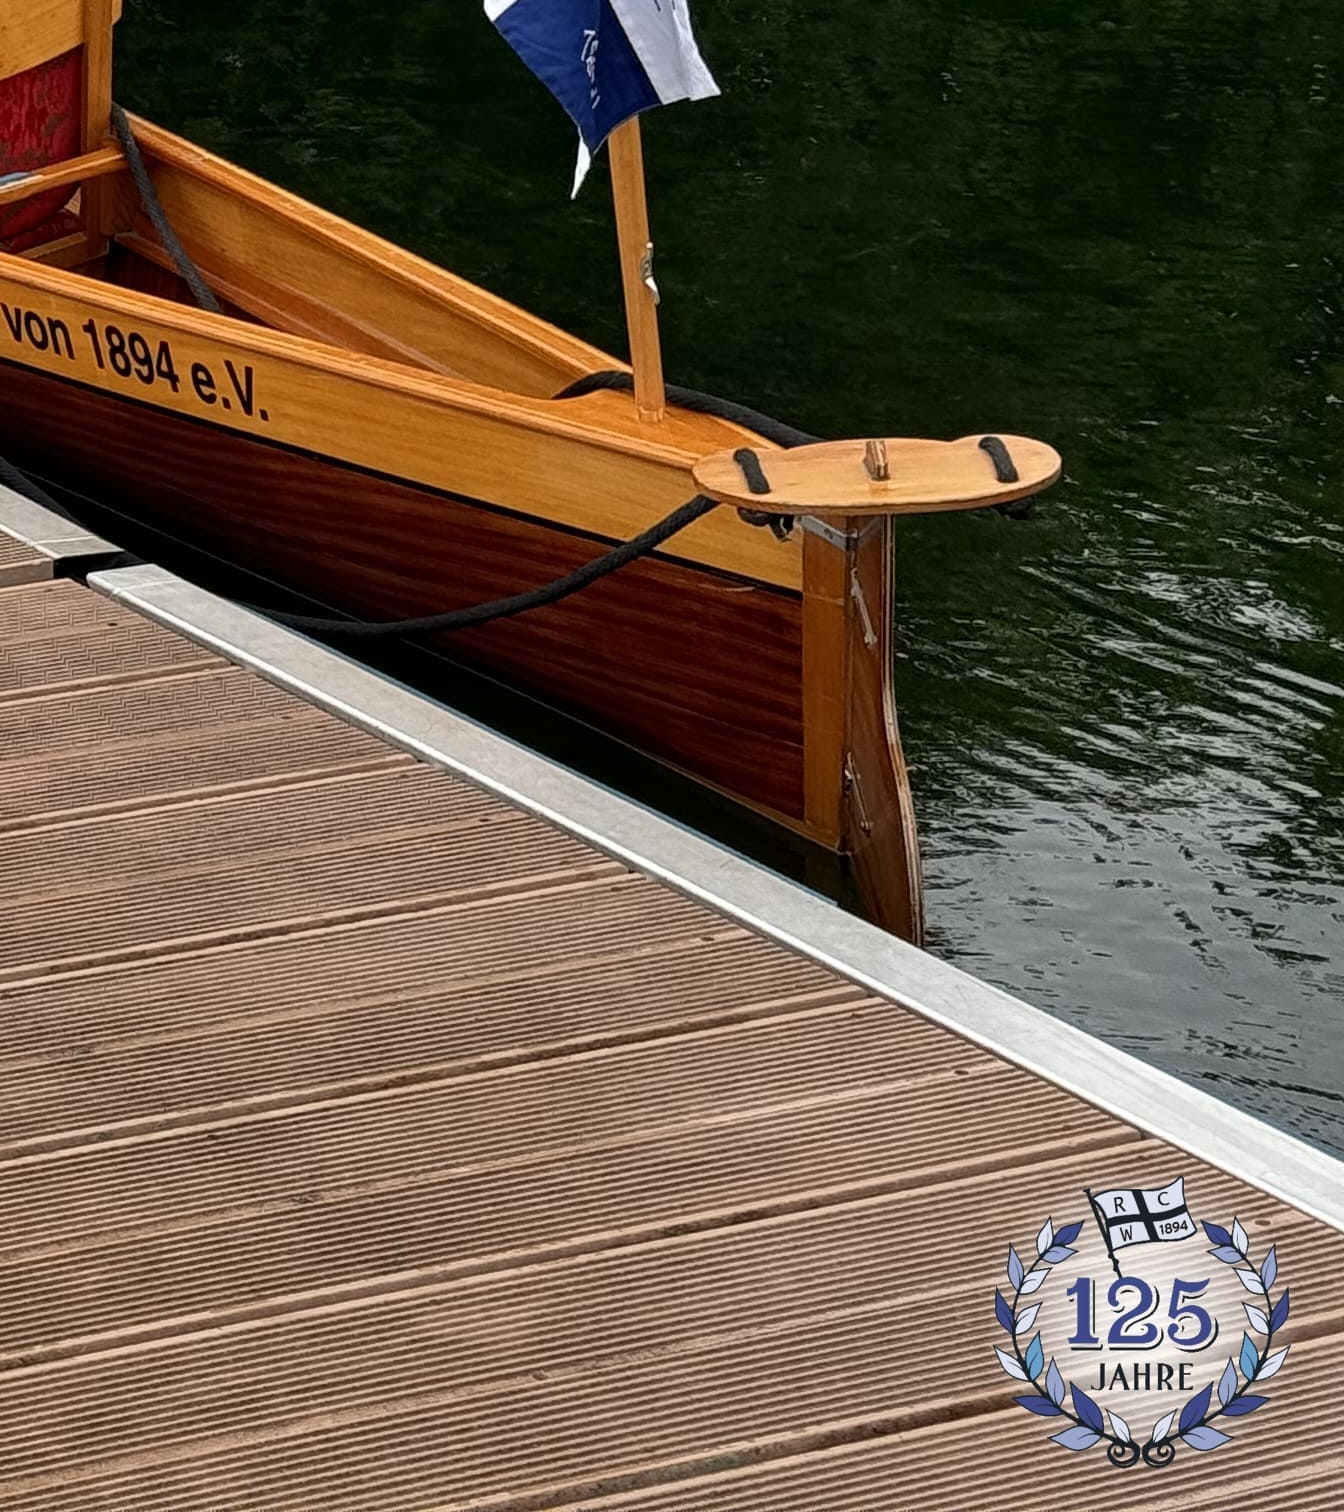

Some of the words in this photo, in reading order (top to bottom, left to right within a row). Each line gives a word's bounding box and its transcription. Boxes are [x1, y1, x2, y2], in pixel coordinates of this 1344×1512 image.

[0, 301, 76, 361] von
[82, 318, 180, 393] 1894
[191, 359, 270, 422] e.V.
